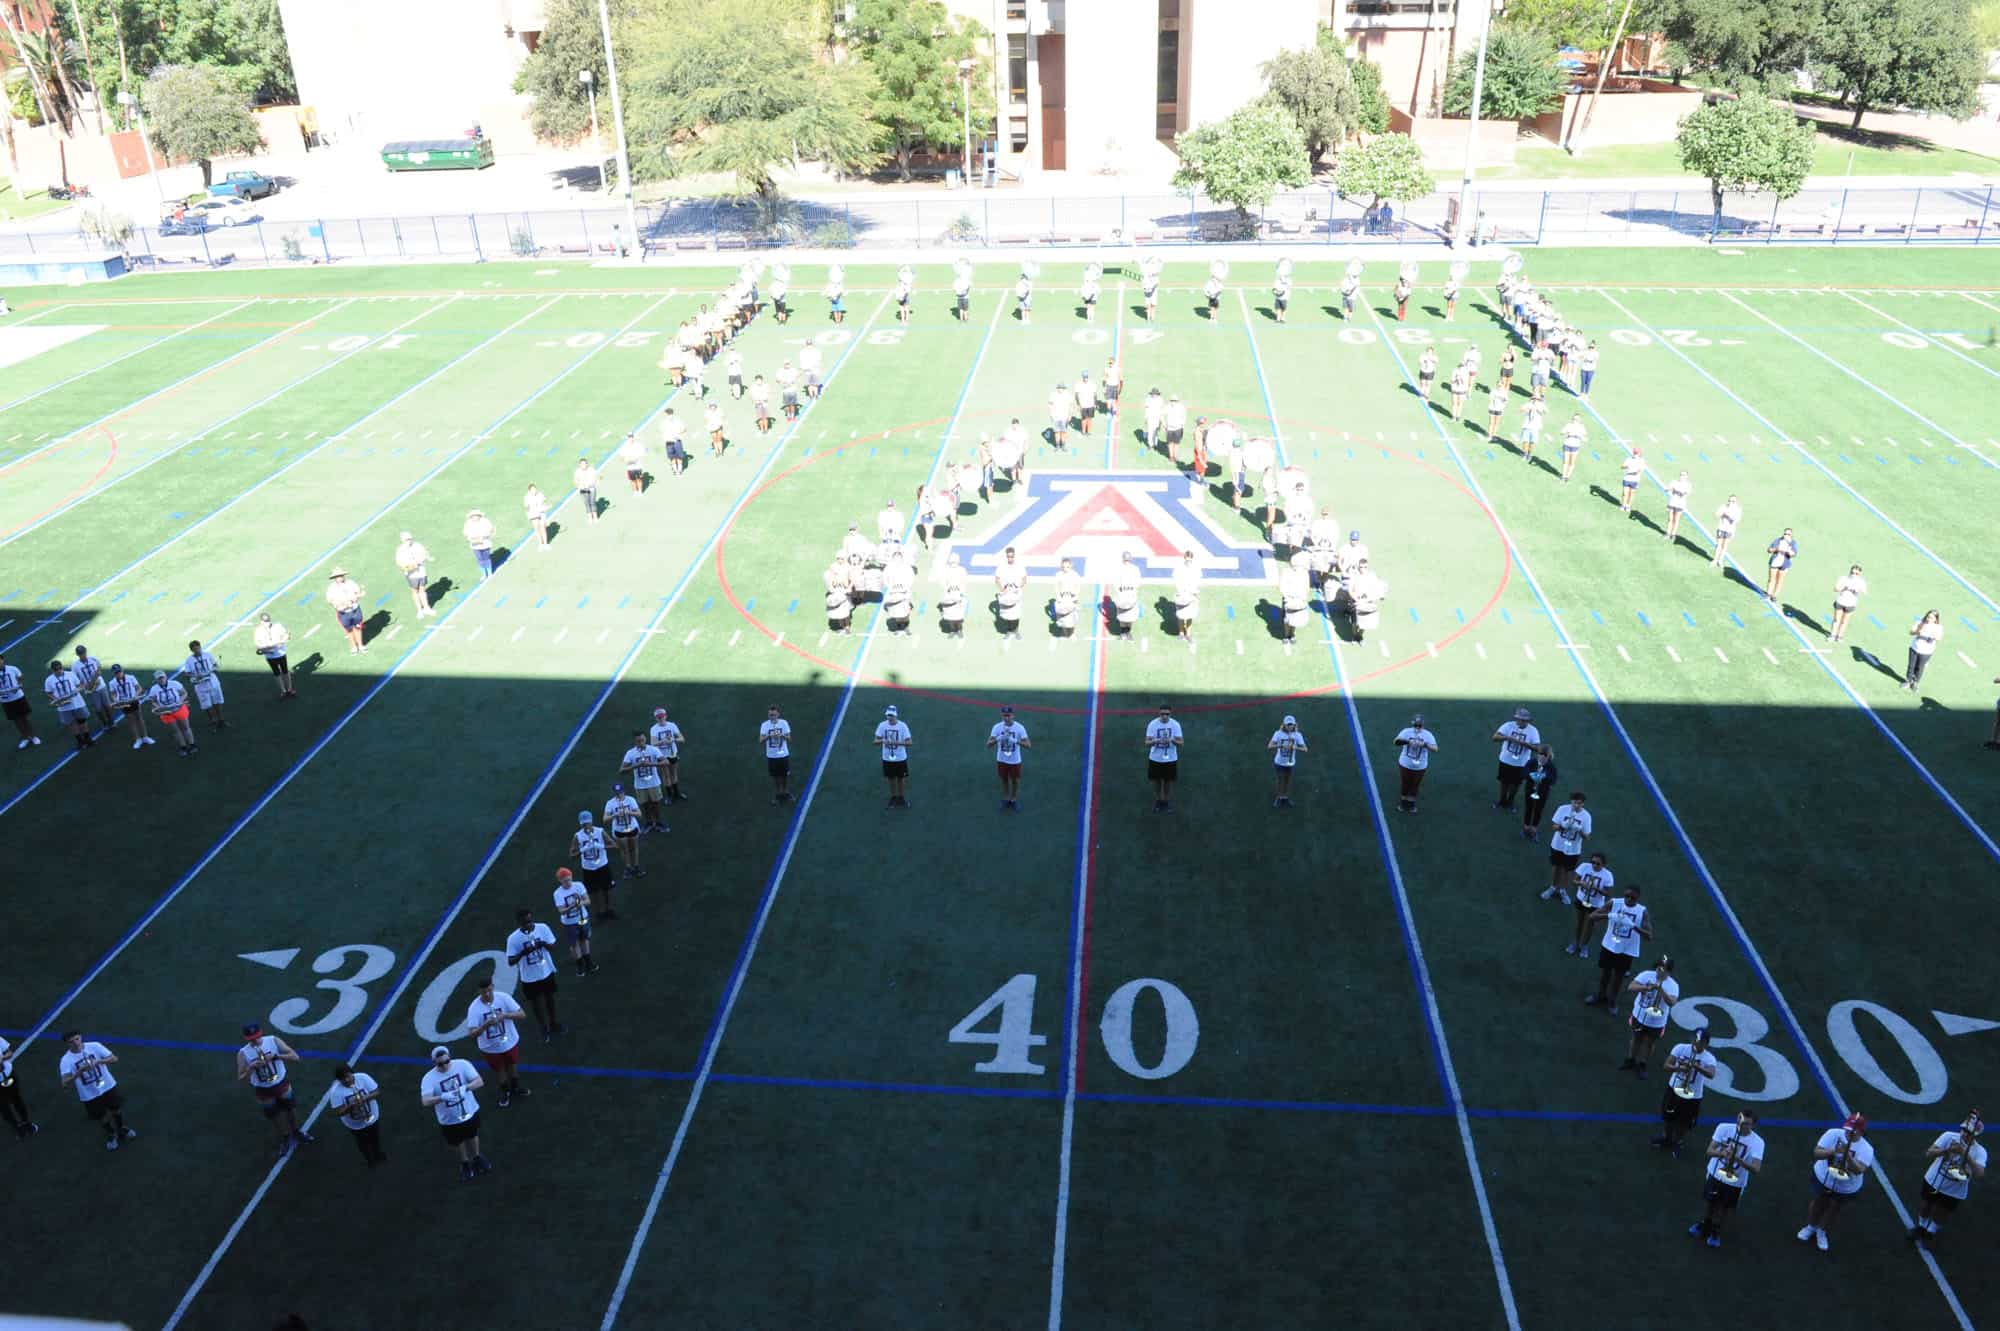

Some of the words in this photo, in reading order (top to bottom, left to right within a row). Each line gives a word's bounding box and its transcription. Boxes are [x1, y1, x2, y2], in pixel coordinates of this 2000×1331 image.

[940, 473, 1268, 580] A
[269, 944, 519, 1043] 30
[949, 973, 1200, 1079] 40
[1670, 996, 1948, 1104] 30
